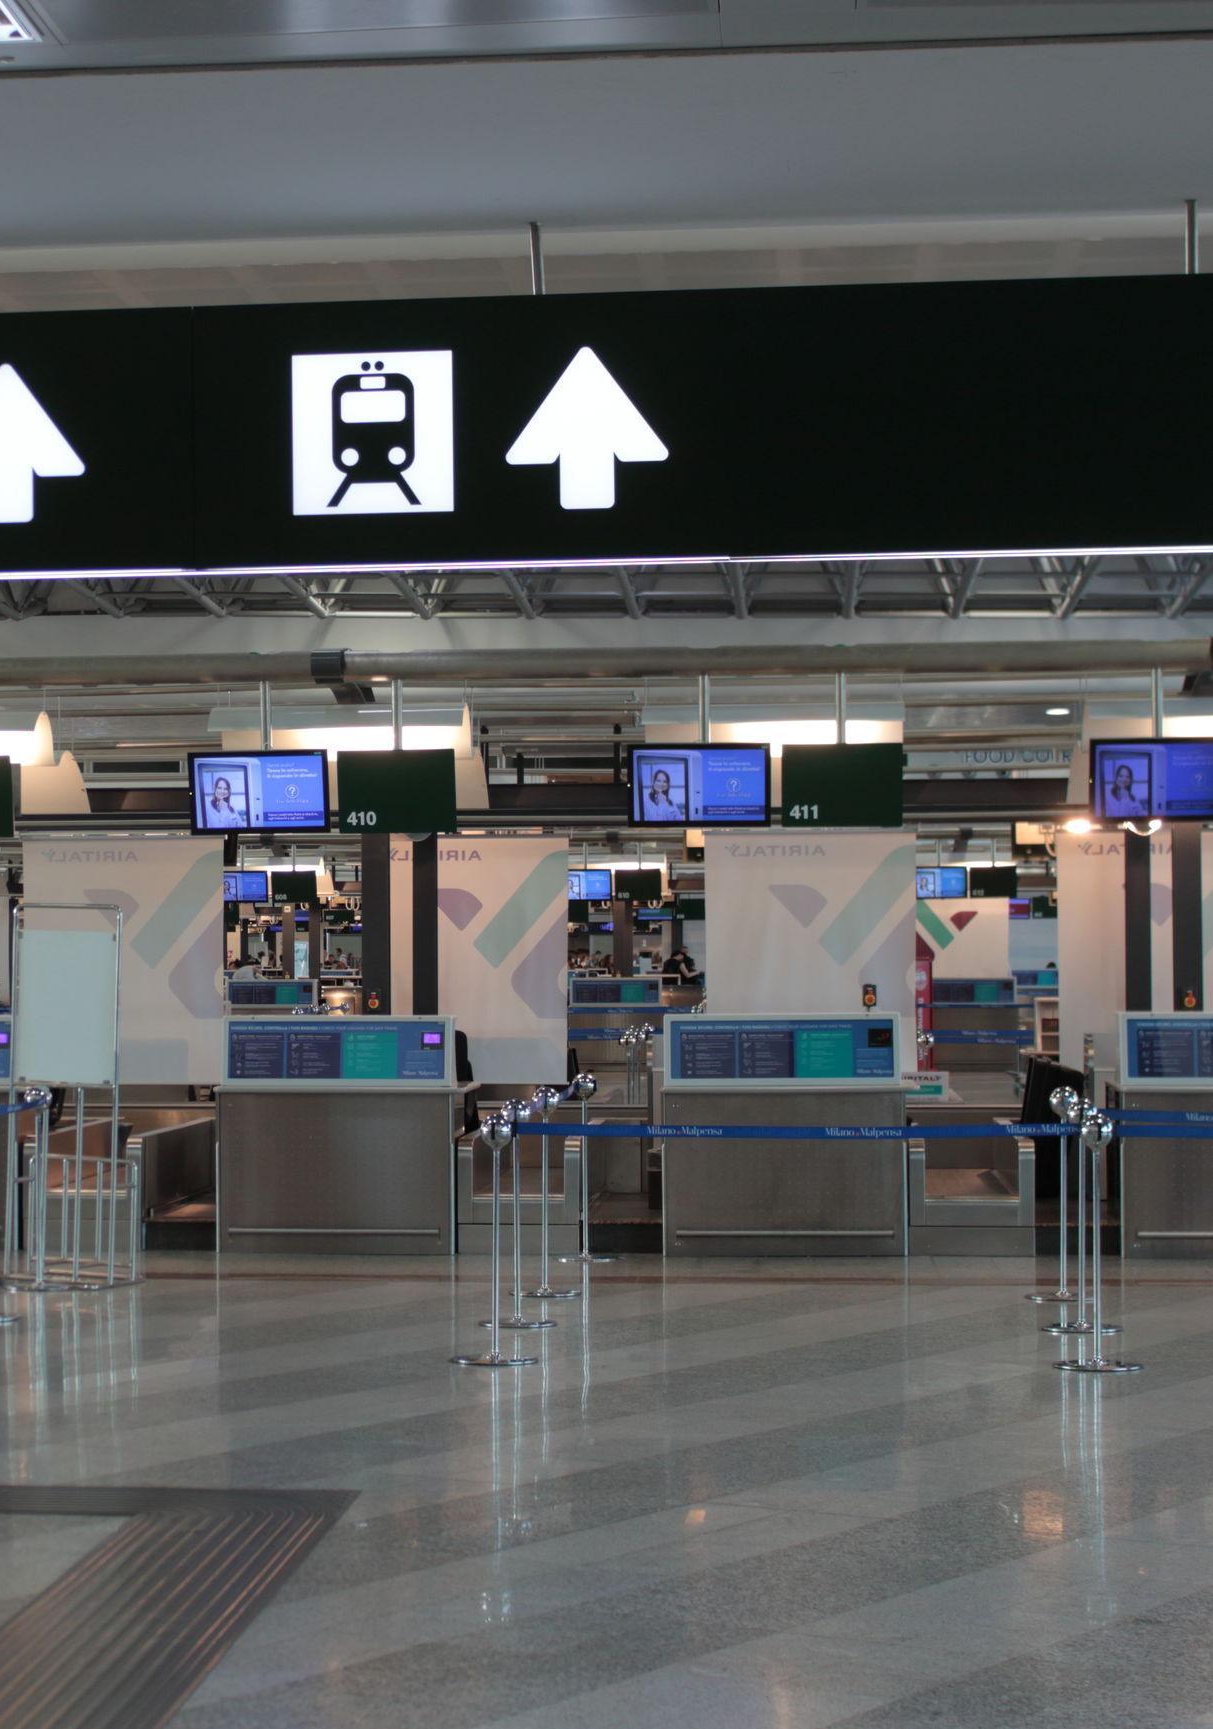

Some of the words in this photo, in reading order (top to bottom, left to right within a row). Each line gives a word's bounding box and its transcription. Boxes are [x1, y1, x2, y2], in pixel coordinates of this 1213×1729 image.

[965, 751, 1014, 763] FOOD
[790, 804, 819, 820] 411
[347, 810, 377, 826] 410
[647, 1126, 676, 1135] Milano
[681, 1126, 723, 1136] Malpensa
[825, 1127, 854, 1136] Milano
[860, 1127, 902, 1138] Malpensa
[1006, 1124, 1036, 1134] Milano
